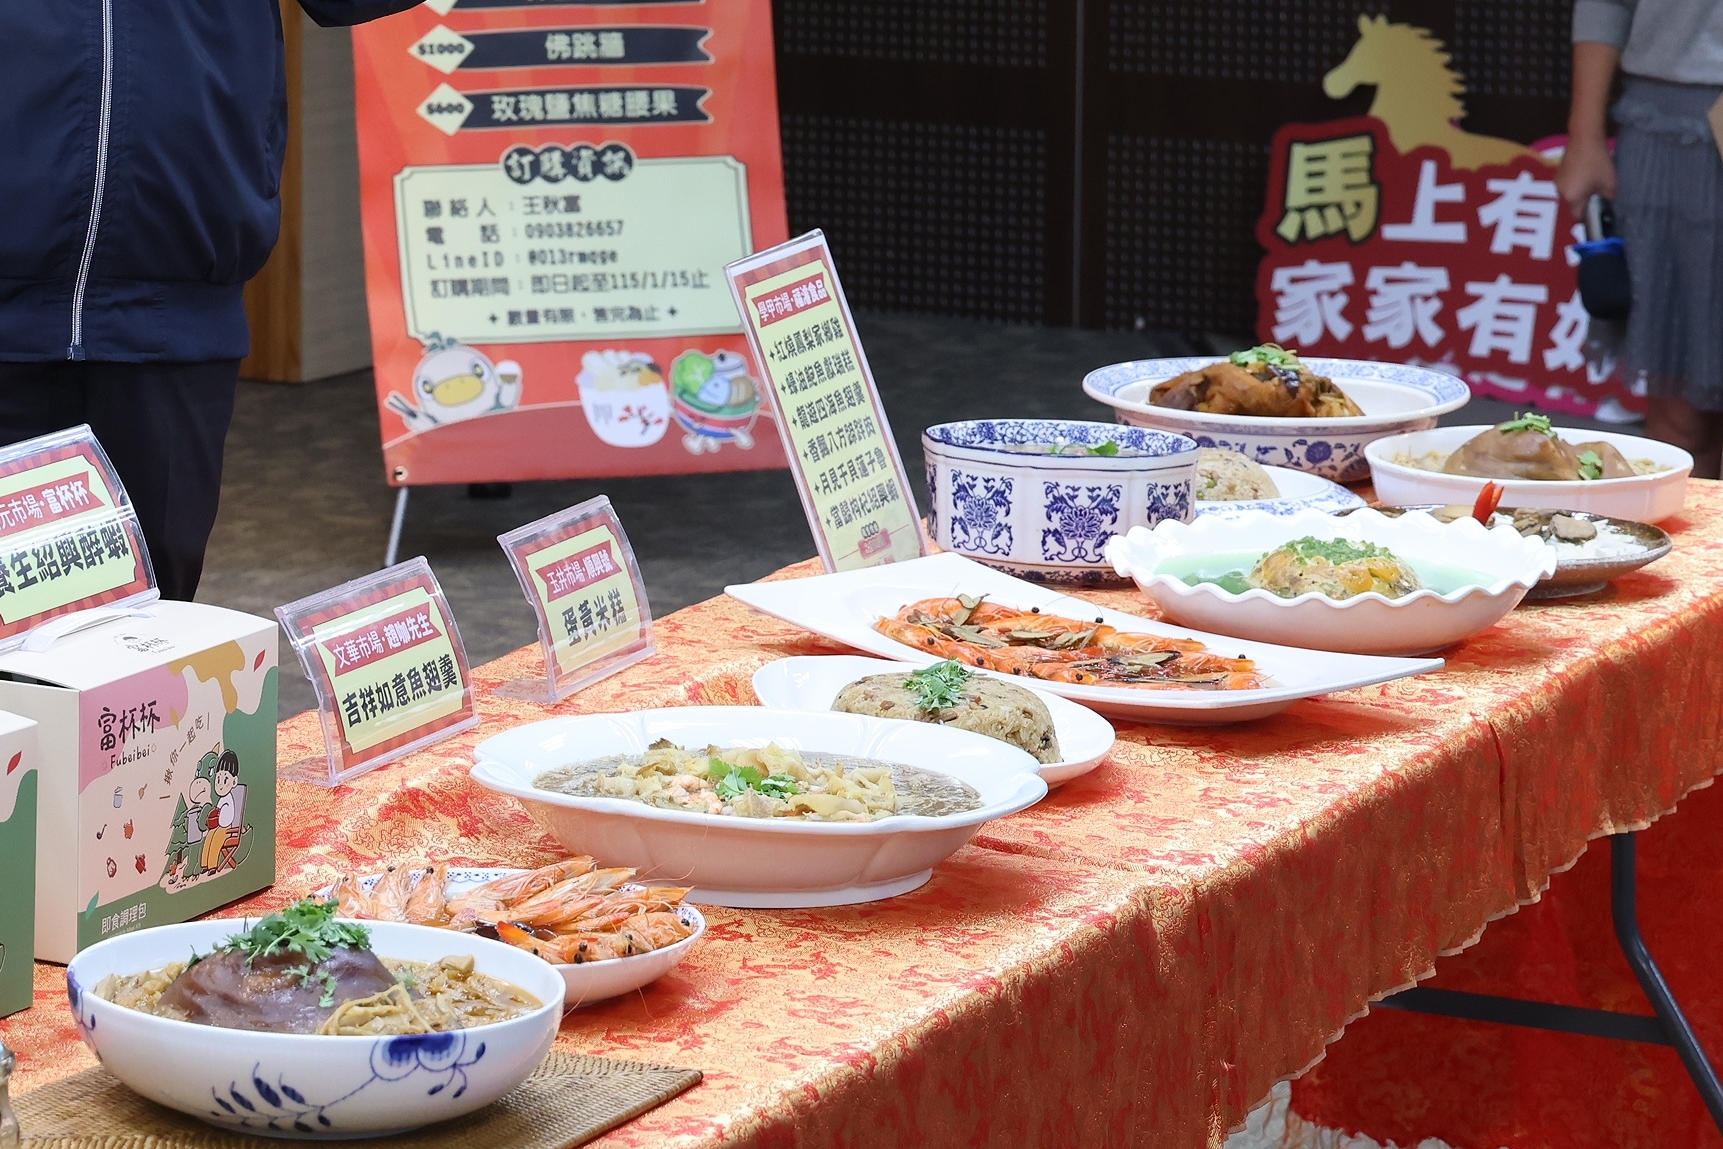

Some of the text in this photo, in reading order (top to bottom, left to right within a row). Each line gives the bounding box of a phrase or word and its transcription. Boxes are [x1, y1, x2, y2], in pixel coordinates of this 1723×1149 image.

[1275, 134, 1588, 267] 馬上有
[342, 654, 459, 729] 吉祥如意魚翅羹
[98, 700, 161, 752] 富杯杯
[109, 744, 151, 770] Fubeibei
[101, 902, 148, 935] 即食調理包
